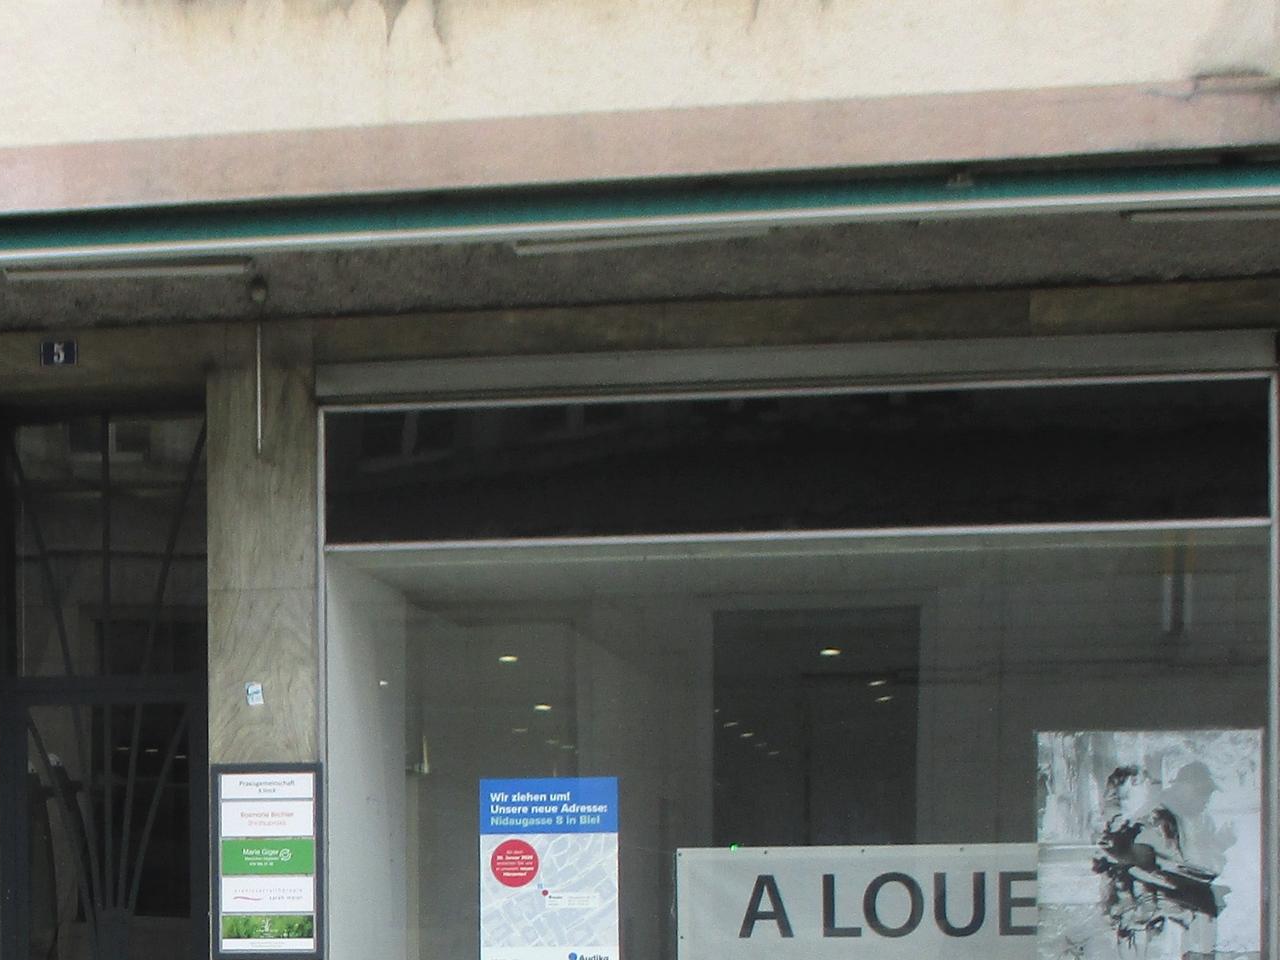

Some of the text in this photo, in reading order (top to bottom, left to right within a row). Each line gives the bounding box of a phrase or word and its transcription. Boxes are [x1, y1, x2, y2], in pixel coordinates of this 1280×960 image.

[53, 342, 65, 364] 5
[490, 791, 571, 802] Wir ziehen um!
[490, 803, 608, 814] Unsere neue Adresse:
[490, 816, 553, 827] Nidaugasse
[566, 815, 576, 825] in
[580, 815, 600, 825] Biel
[739, 871, 1038, 938] A LOUE
